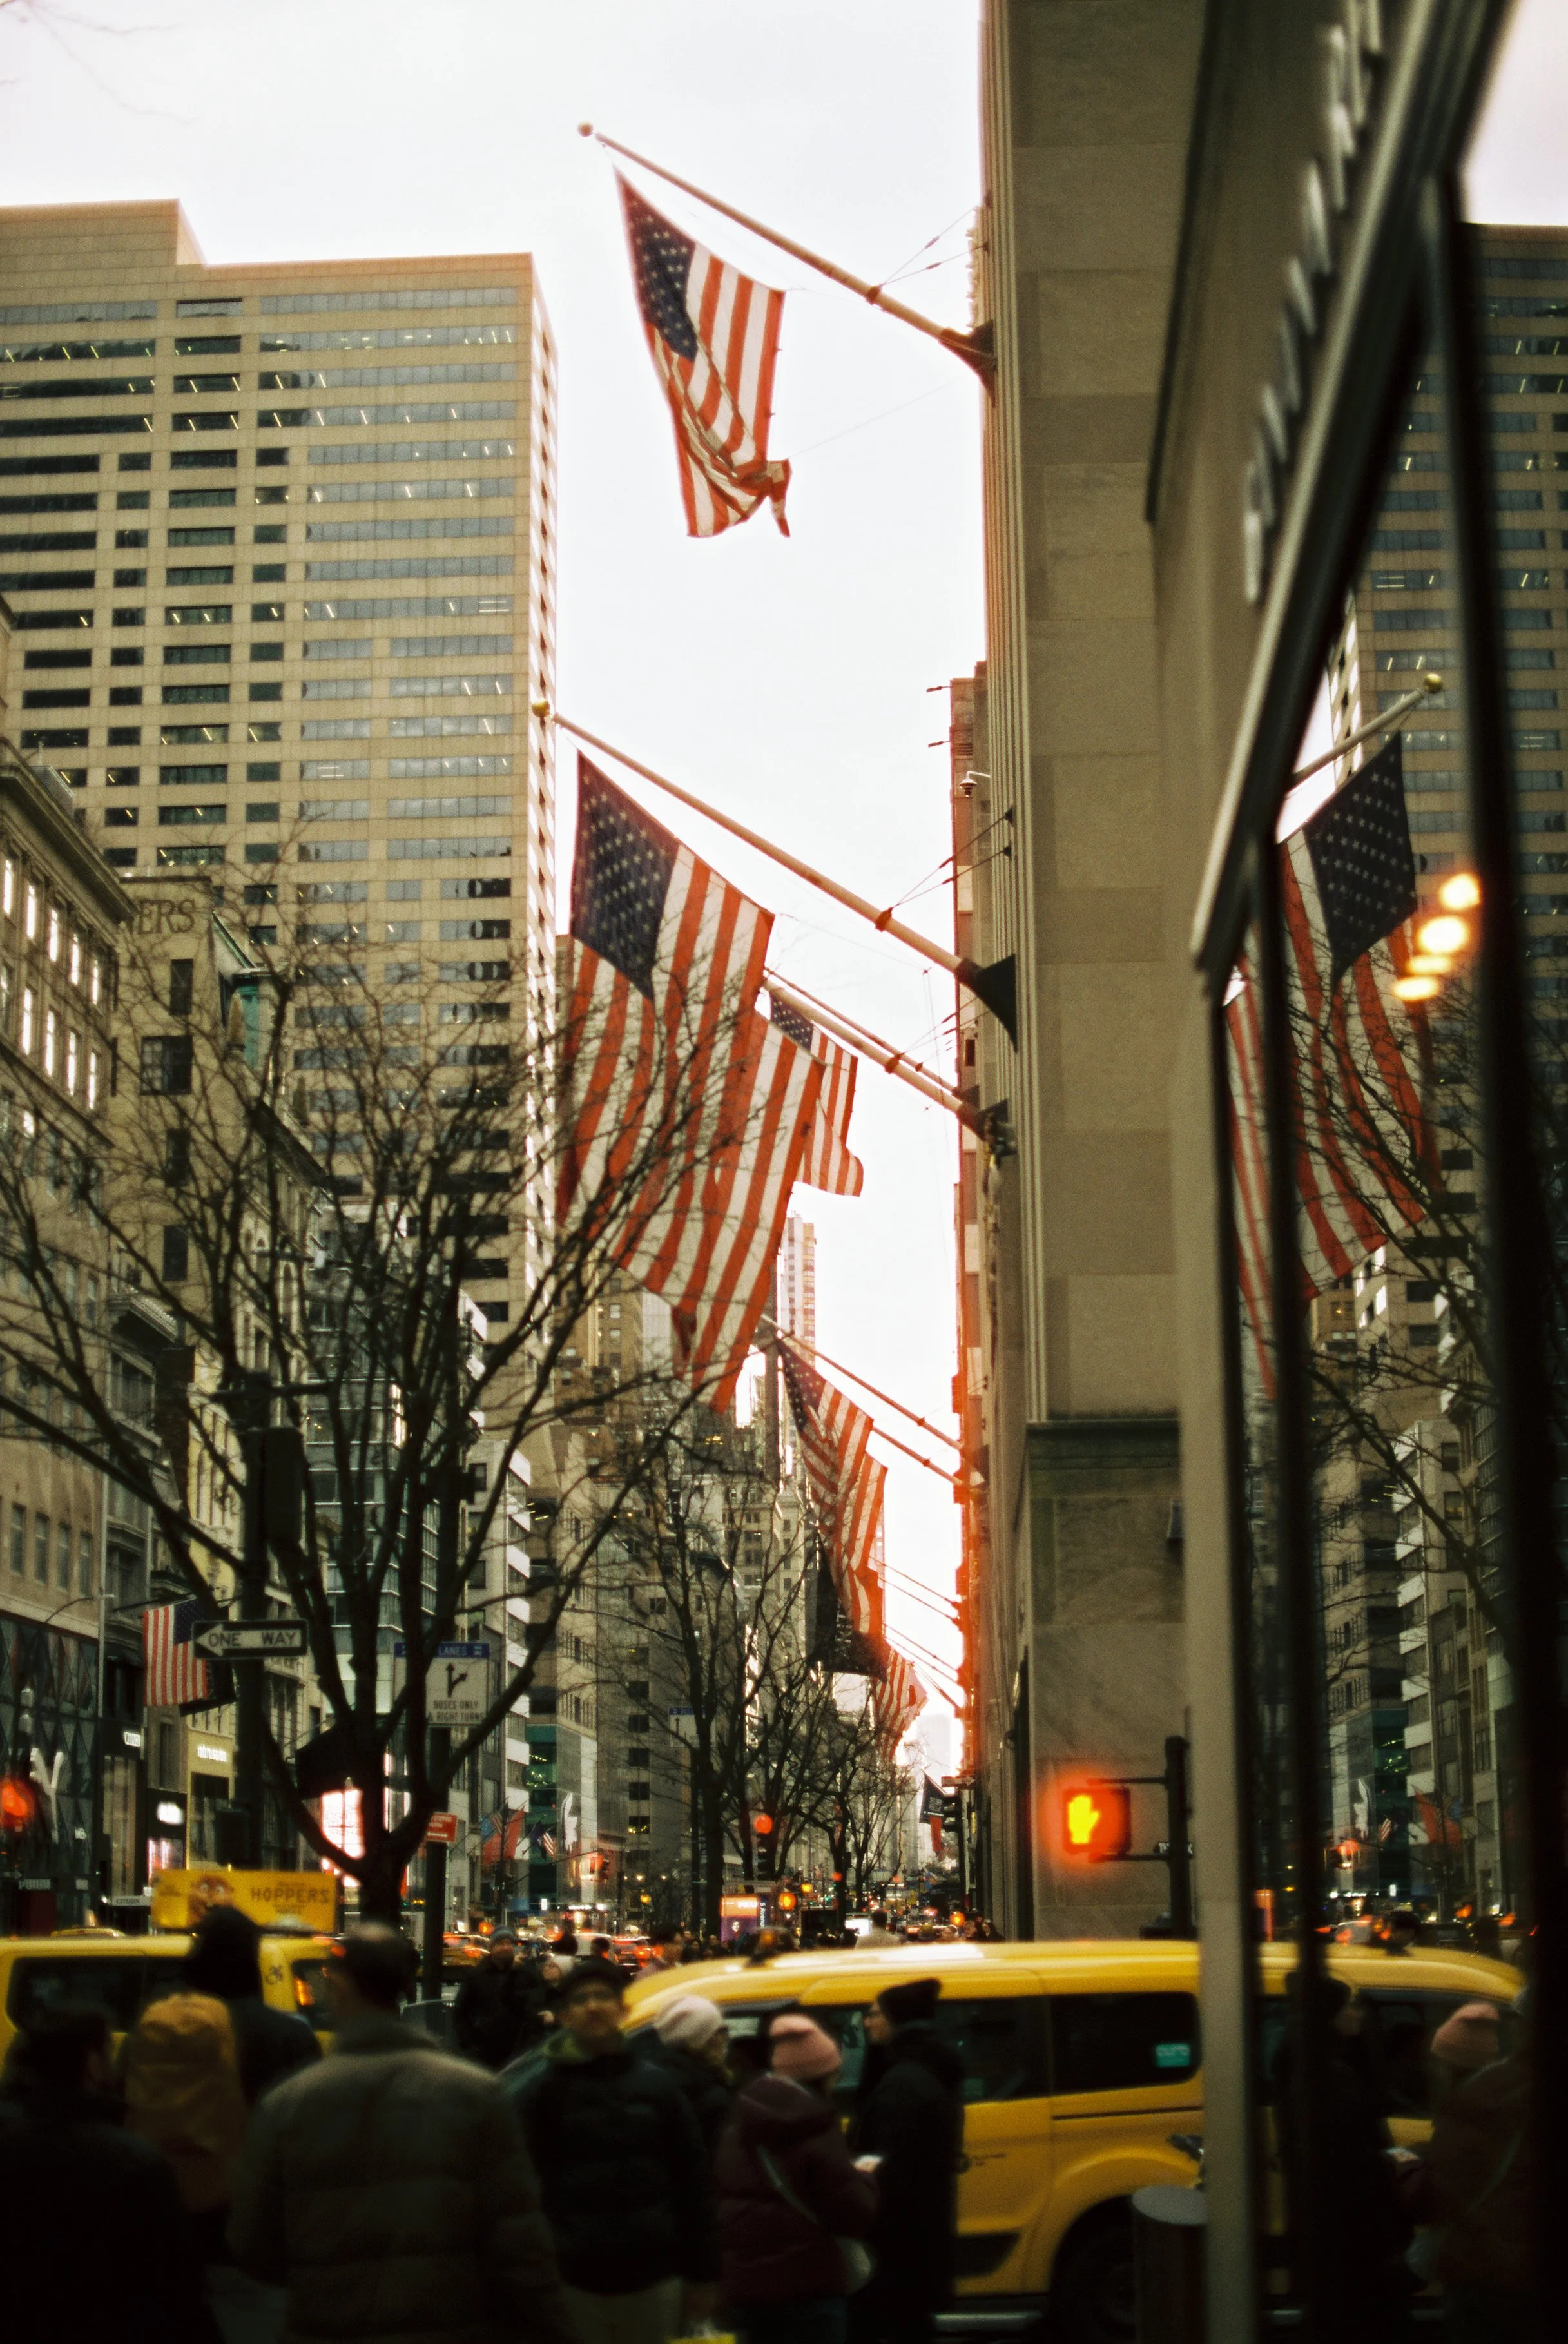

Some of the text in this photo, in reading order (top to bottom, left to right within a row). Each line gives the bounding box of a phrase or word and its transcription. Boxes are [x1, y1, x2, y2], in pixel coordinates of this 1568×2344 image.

[208, 1631, 297, 1647] ONE WAY
[434, 1700, 478, 1709] BUSES ONLY
[436, 1712, 458, 1721] RIGHT
[461, 1712, 484, 1721] TURNS
[251, 1887, 329, 1904] HOPPERS
